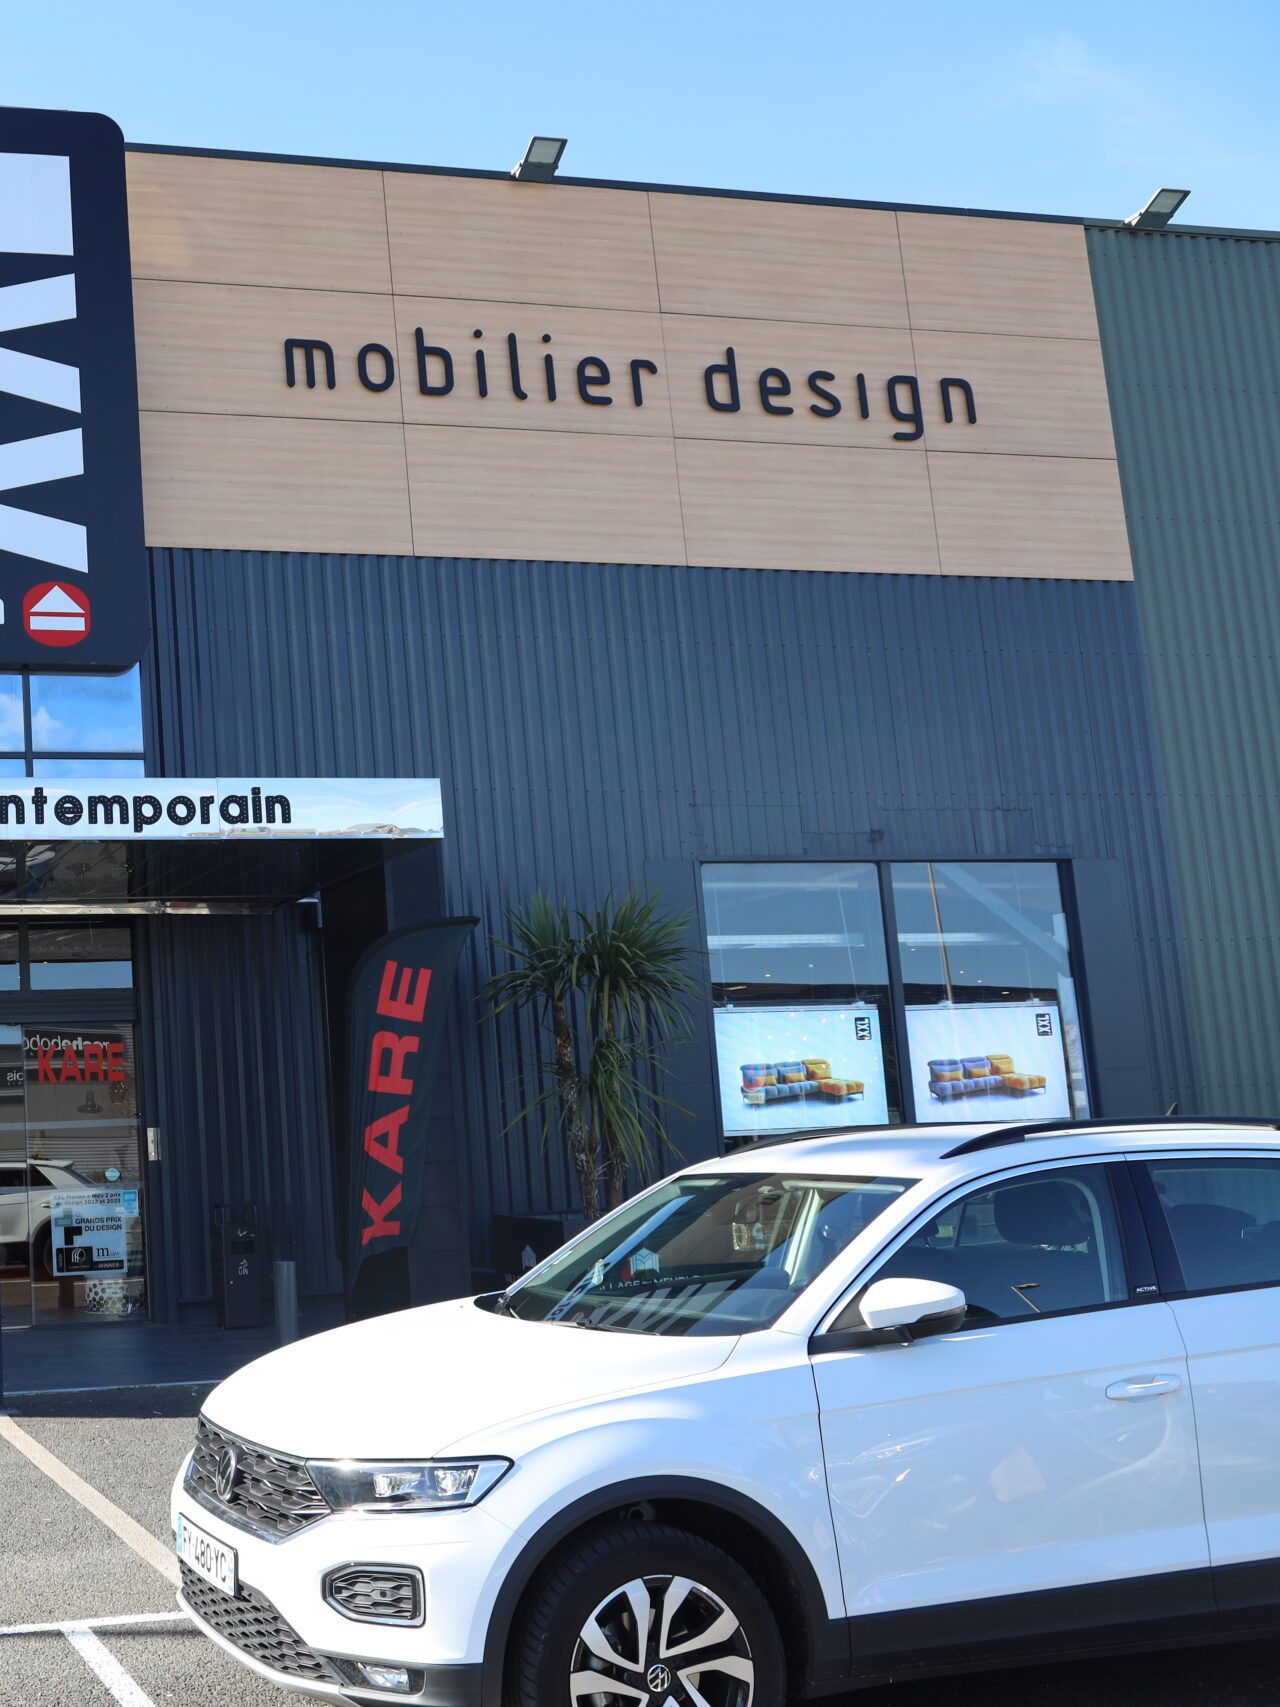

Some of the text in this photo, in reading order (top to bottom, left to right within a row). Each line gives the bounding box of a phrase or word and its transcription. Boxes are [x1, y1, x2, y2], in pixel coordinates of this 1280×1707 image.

[284, 327, 977, 441] mobilier design
[856, 1018, 870, 1037] XXL
[1037, 1014, 1050, 1033] XXL
[37, 1043, 127, 1084] KARE
[362, 960, 432, 1246] KARE
[75, 1217, 105, 1225] GRANDS
